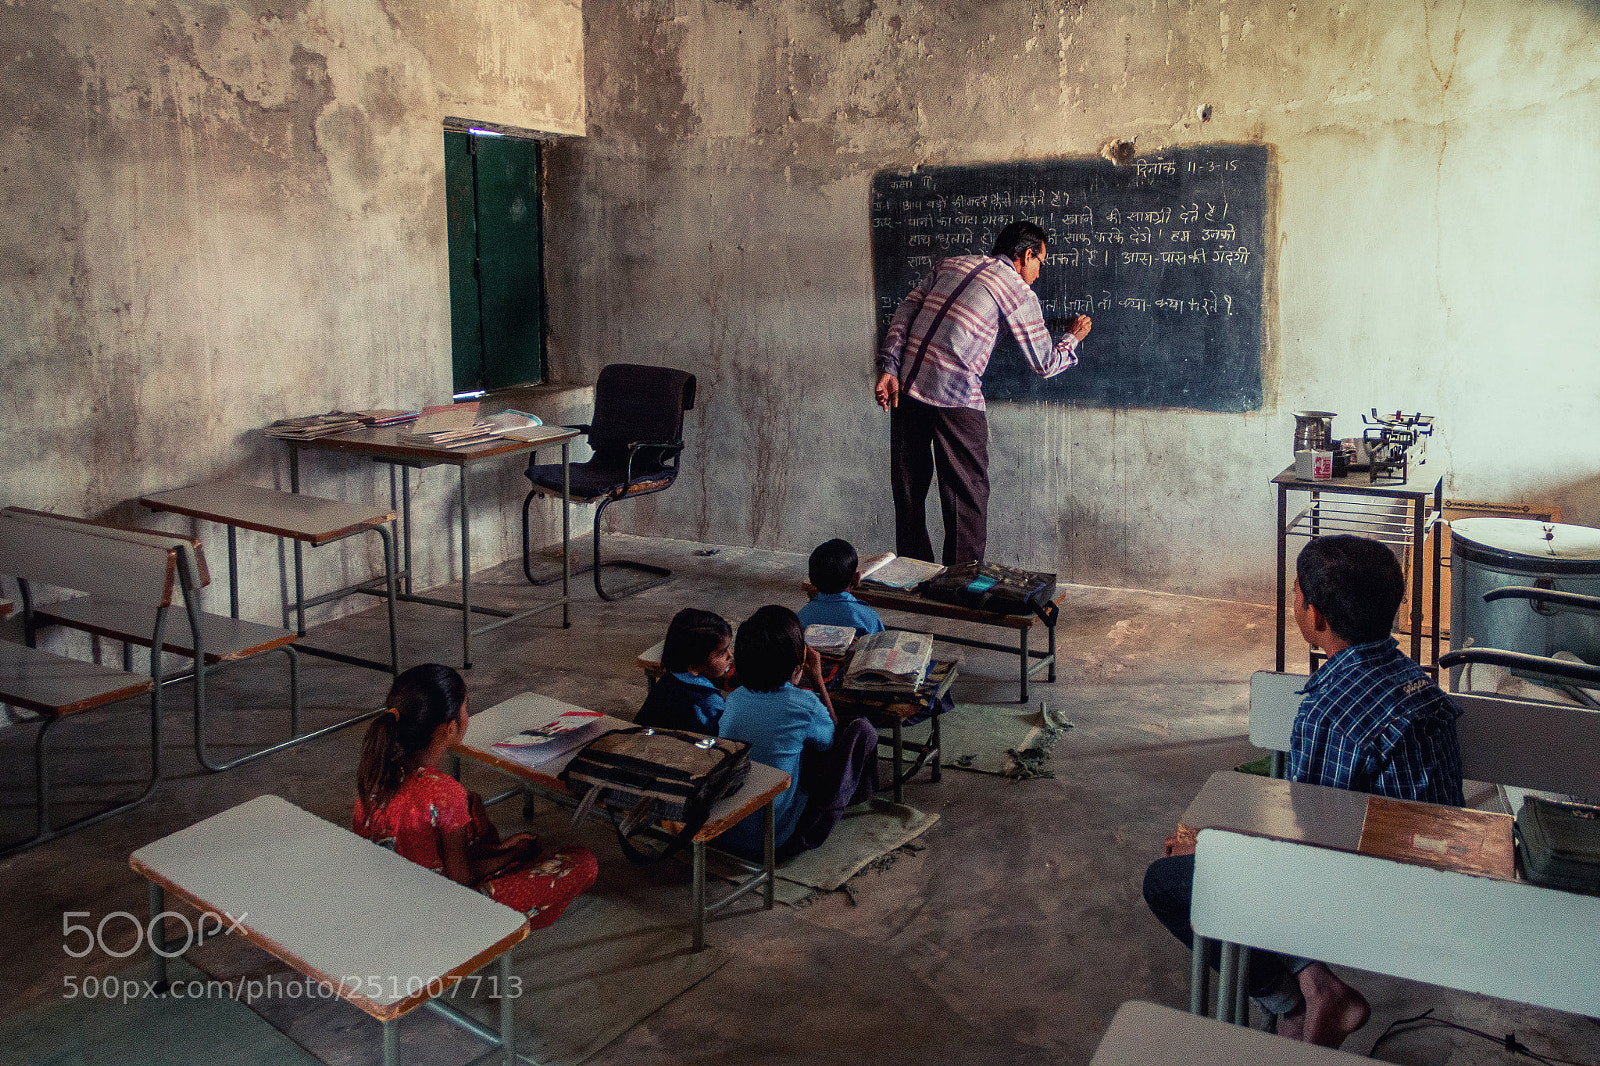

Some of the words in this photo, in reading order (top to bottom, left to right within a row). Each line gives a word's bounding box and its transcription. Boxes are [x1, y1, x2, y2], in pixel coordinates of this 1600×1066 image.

[1136, 156, 1177, 177] दिनांक
[1187, 159, 1238, 174] 11-3-15
[1170, 229, 1191, 243] हम
